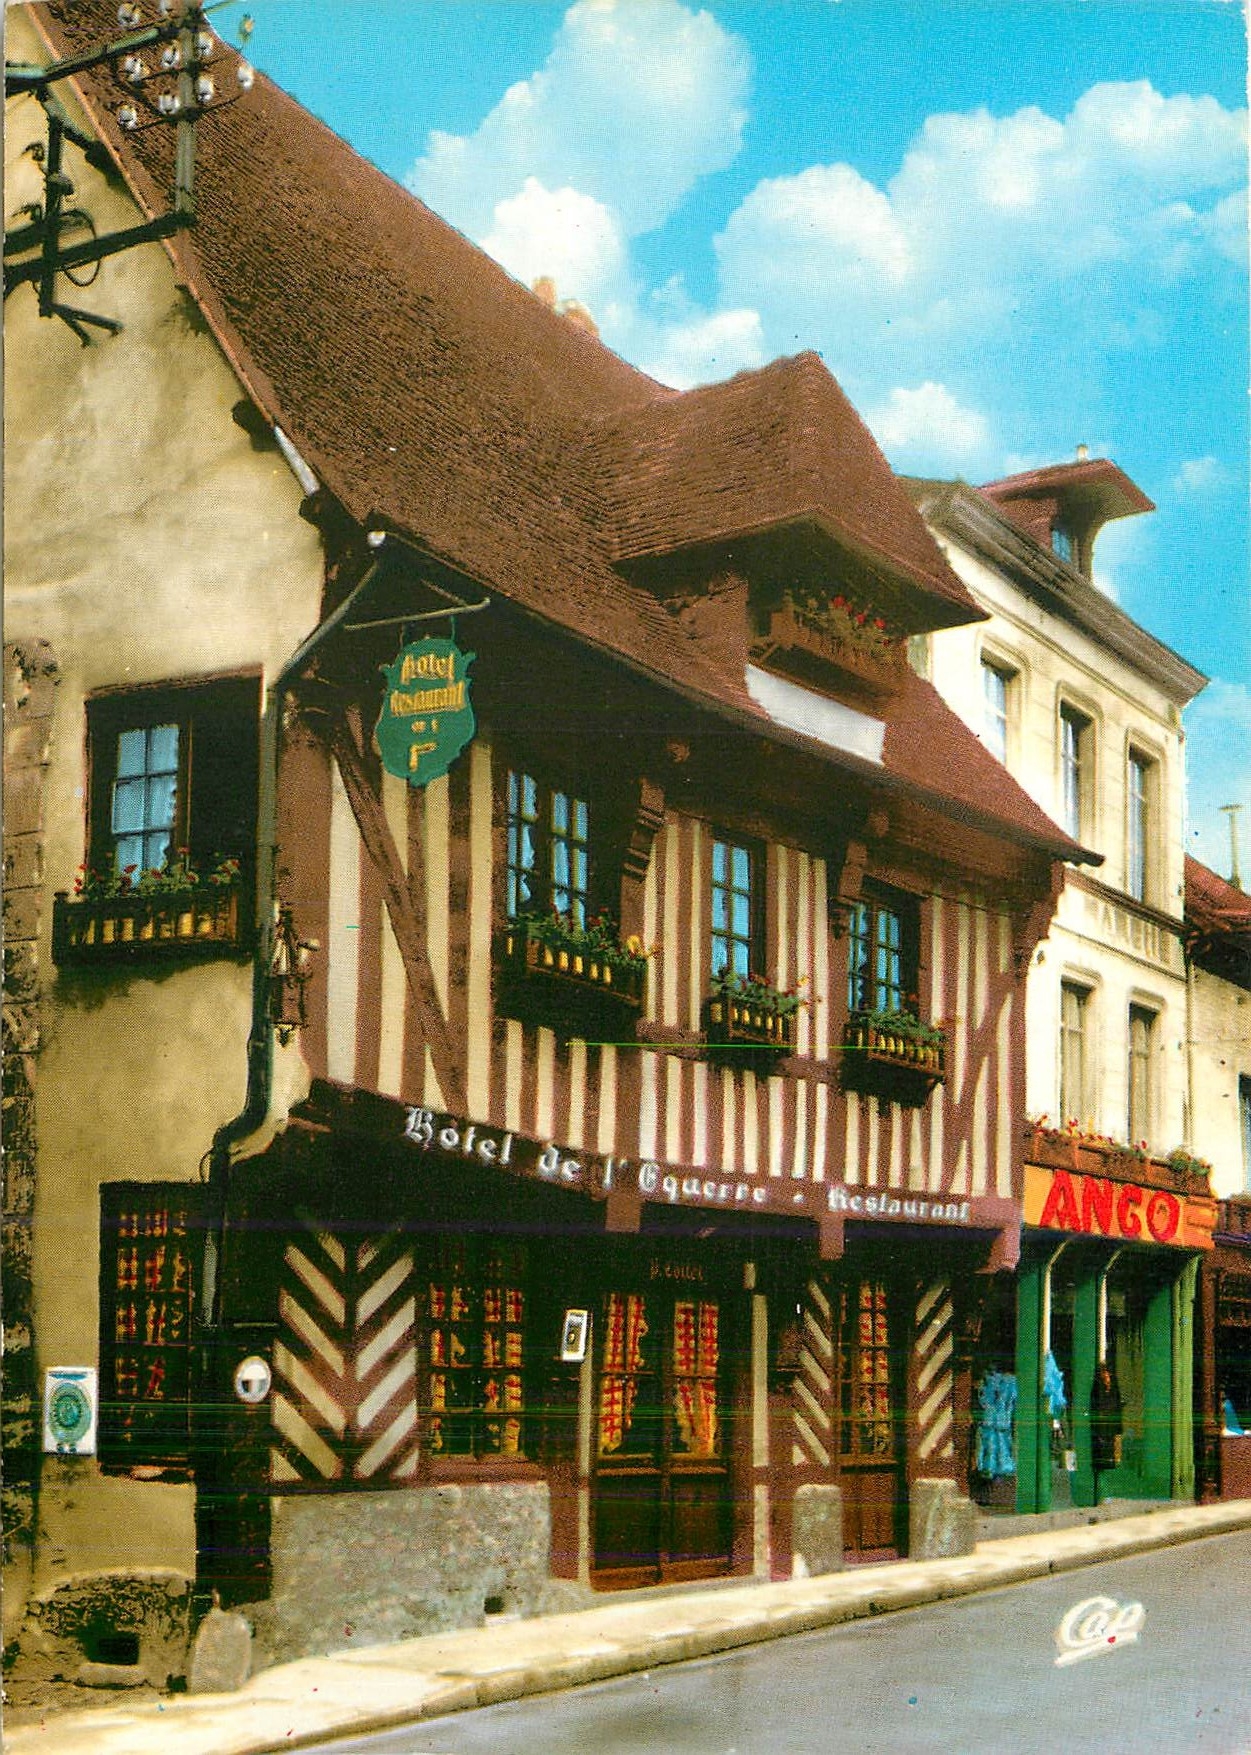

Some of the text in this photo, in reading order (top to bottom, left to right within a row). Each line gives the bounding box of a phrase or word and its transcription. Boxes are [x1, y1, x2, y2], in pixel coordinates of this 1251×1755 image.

[538, 1144, 581, 1180] de
[827, 1186, 971, 1223] Restaurant
[1039, 1168, 1181, 1243] ANGO
